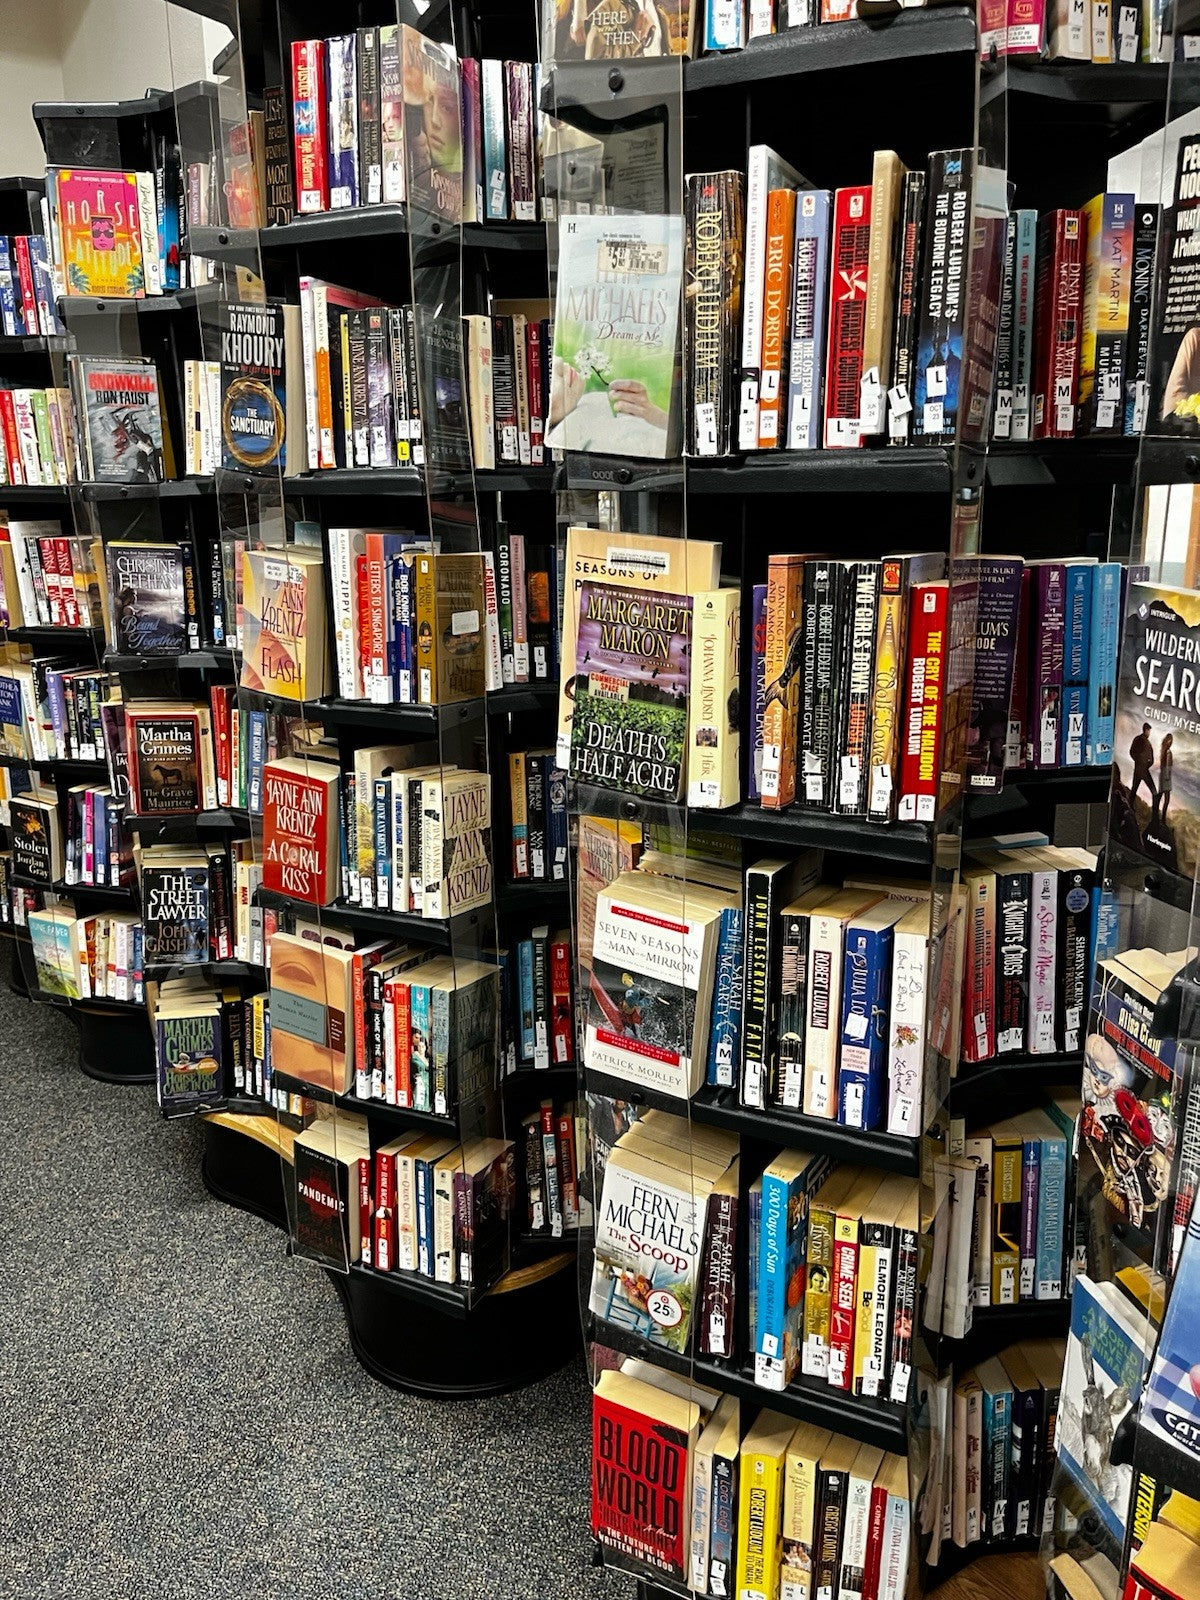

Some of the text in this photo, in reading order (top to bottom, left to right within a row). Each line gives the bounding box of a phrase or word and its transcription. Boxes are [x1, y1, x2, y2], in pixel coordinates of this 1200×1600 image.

[591, 10, 627, 26] HERE
[604, 31, 642, 45] THEN
[297, 64, 311, 101] Justice
[301, 154, 315, 190] Kellerman
[66, 189, 136, 230] HORSE
[951, 191, 967, 242] ROBERT
[905, 222, 916, 268] MIDNIGHT
[929, 192, 949, 318] THE BOURNE LEGACY
[695, 211, 722, 369] ROBERT LUDLUM
[765, 233, 784, 341] ERIC DORIS
[794, 238, 816, 339] ROBERT LUDLUM
[1108, 236, 1122, 322] KAT MARTIN
[1133, 247, 1151, 303] MONING
[230, 313, 276, 335] RAYMOND
[565, 286, 669, 325] MICHAELS
[222, 332, 284, 369] KHOURY
[119, 389, 150, 405] FAUST
[247, 407, 258, 418] THE
[929, 404, 942, 413] OCT
[229, 414, 275, 437] SANCTUARY
[116, 556, 176, 574] CHRISTINE
[499, 544, 511, 605] CORONADO
[280, 588, 304, 613] ANN
[340, 580, 351, 614] ZIPPY
[399, 574, 410, 627] BOB KNIGHT
[485, 568, 497, 616] CARRIERS
[857, 571, 876, 603] TWO
[260, 596, 304, 638] KRENTZ
[369, 560, 382, 655] LETTERS TO SINGAPORE
[587, 595, 693, 635] MARGARET
[766, 579, 777, 674] AND AMMONITES
[775, 585, 786, 664] DANCING FISH
[852, 606, 873, 648] GIRLS
[1150, 609, 1176, 622] INTRIGUE
[128, 632, 182, 650] Together
[600, 624, 671, 660] MARON
[1071, 593, 1084, 677] MARGARET MARON
[261, 647, 303, 686] FLASH
[590, 672, 629, 688] COMMERCIAL
[803, 603, 816, 745] ROBERT LUDLUM and GAYLE
[850, 651, 869, 694] DOWN
[594, 689, 625, 700] AVAILABLE
[600, 682, 620, 693] SPACE
[907, 657, 925, 756] ROBERT LUDLUM
[918, 630, 942, 781] THE CRY OF THE HALIDON
[139, 727, 192, 742] Martha
[140, 740, 192, 756] Grimes
[586, 721, 667, 763] DEATH'S
[574, 747, 676, 792] HALF ACRE
[144, 787, 194, 798] The Grave
[147, 797, 192, 808] Maurice
[266, 778, 323, 817] JAYNE ANN
[450, 788, 487, 830] JAYNE
[276, 804, 316, 838] KRENTZ
[14, 836, 49, 856] Stolen
[16, 852, 45, 869] Jordan
[453, 831, 482, 867] ANN
[28, 863, 49, 880] Gray
[160, 874, 193, 892] THE
[281, 866, 310, 895] KISS
[447, 864, 490, 904] KRENTZ
[147, 904, 207, 921] LAWYER
[149, 888, 204, 907] STREET
[598, 921, 699, 960] SEVEN SEASONS
[752, 894, 767, 1011] JOHN LESCROART
[1001, 898, 1028, 976] KNIGHT'S CROSS
[1075, 936, 1086, 970] SHARYN
[608, 941, 635, 956] MAN
[645, 952, 695, 975] MIRROR
[717, 954, 732, 1018] McCARTY
[731, 965, 743, 1012] SARAH
[811, 951, 830, 1029] ROBERT LUDLUM
[854, 967, 868, 1003] JULIA
[164, 1018, 214, 1038] MARTHA
[1118, 1007, 1140, 1038] Alisa
[1140, 1023, 1163, 1057] Craig
[165, 1034, 214, 1064] GRIMES
[591, 1050, 682, 1086] PATRICK MORLEY
[297, 1181, 345, 1213] PANDEMIC
[632, 1186, 679, 1224] FERN
[1043, 1180, 1060, 1252] SUSAN MALLERY
[605, 1199, 700, 1256] MICHAELS
[767, 1184, 781, 1275] 300 Days of Sun
[811, 1222, 822, 1264] LINDEN
[607, 1226, 689, 1275] The Scoop
[709, 1233, 723, 1289] McCARTY
[720, 1243, 733, 1284] SARAH
[838, 1246, 855, 1311] CRIME SEEN
[877, 1258, 888, 1309] ELMORE
[862, 1291, 873, 1307] Be
[600, 1415, 679, 1493] BLOOD
[596, 1458, 679, 1536] WORLD
[718, 1479, 731, 1534] Lora Leigh
[748, 1488, 767, 1555] ROBERT LUDLUM
[821, 1505, 840, 1564] GREGG LOOMIS
[598, 1531, 675, 1574] WRITTEN IN BLOOD.
[606, 1526, 666, 1561] THE FUTURE IS
